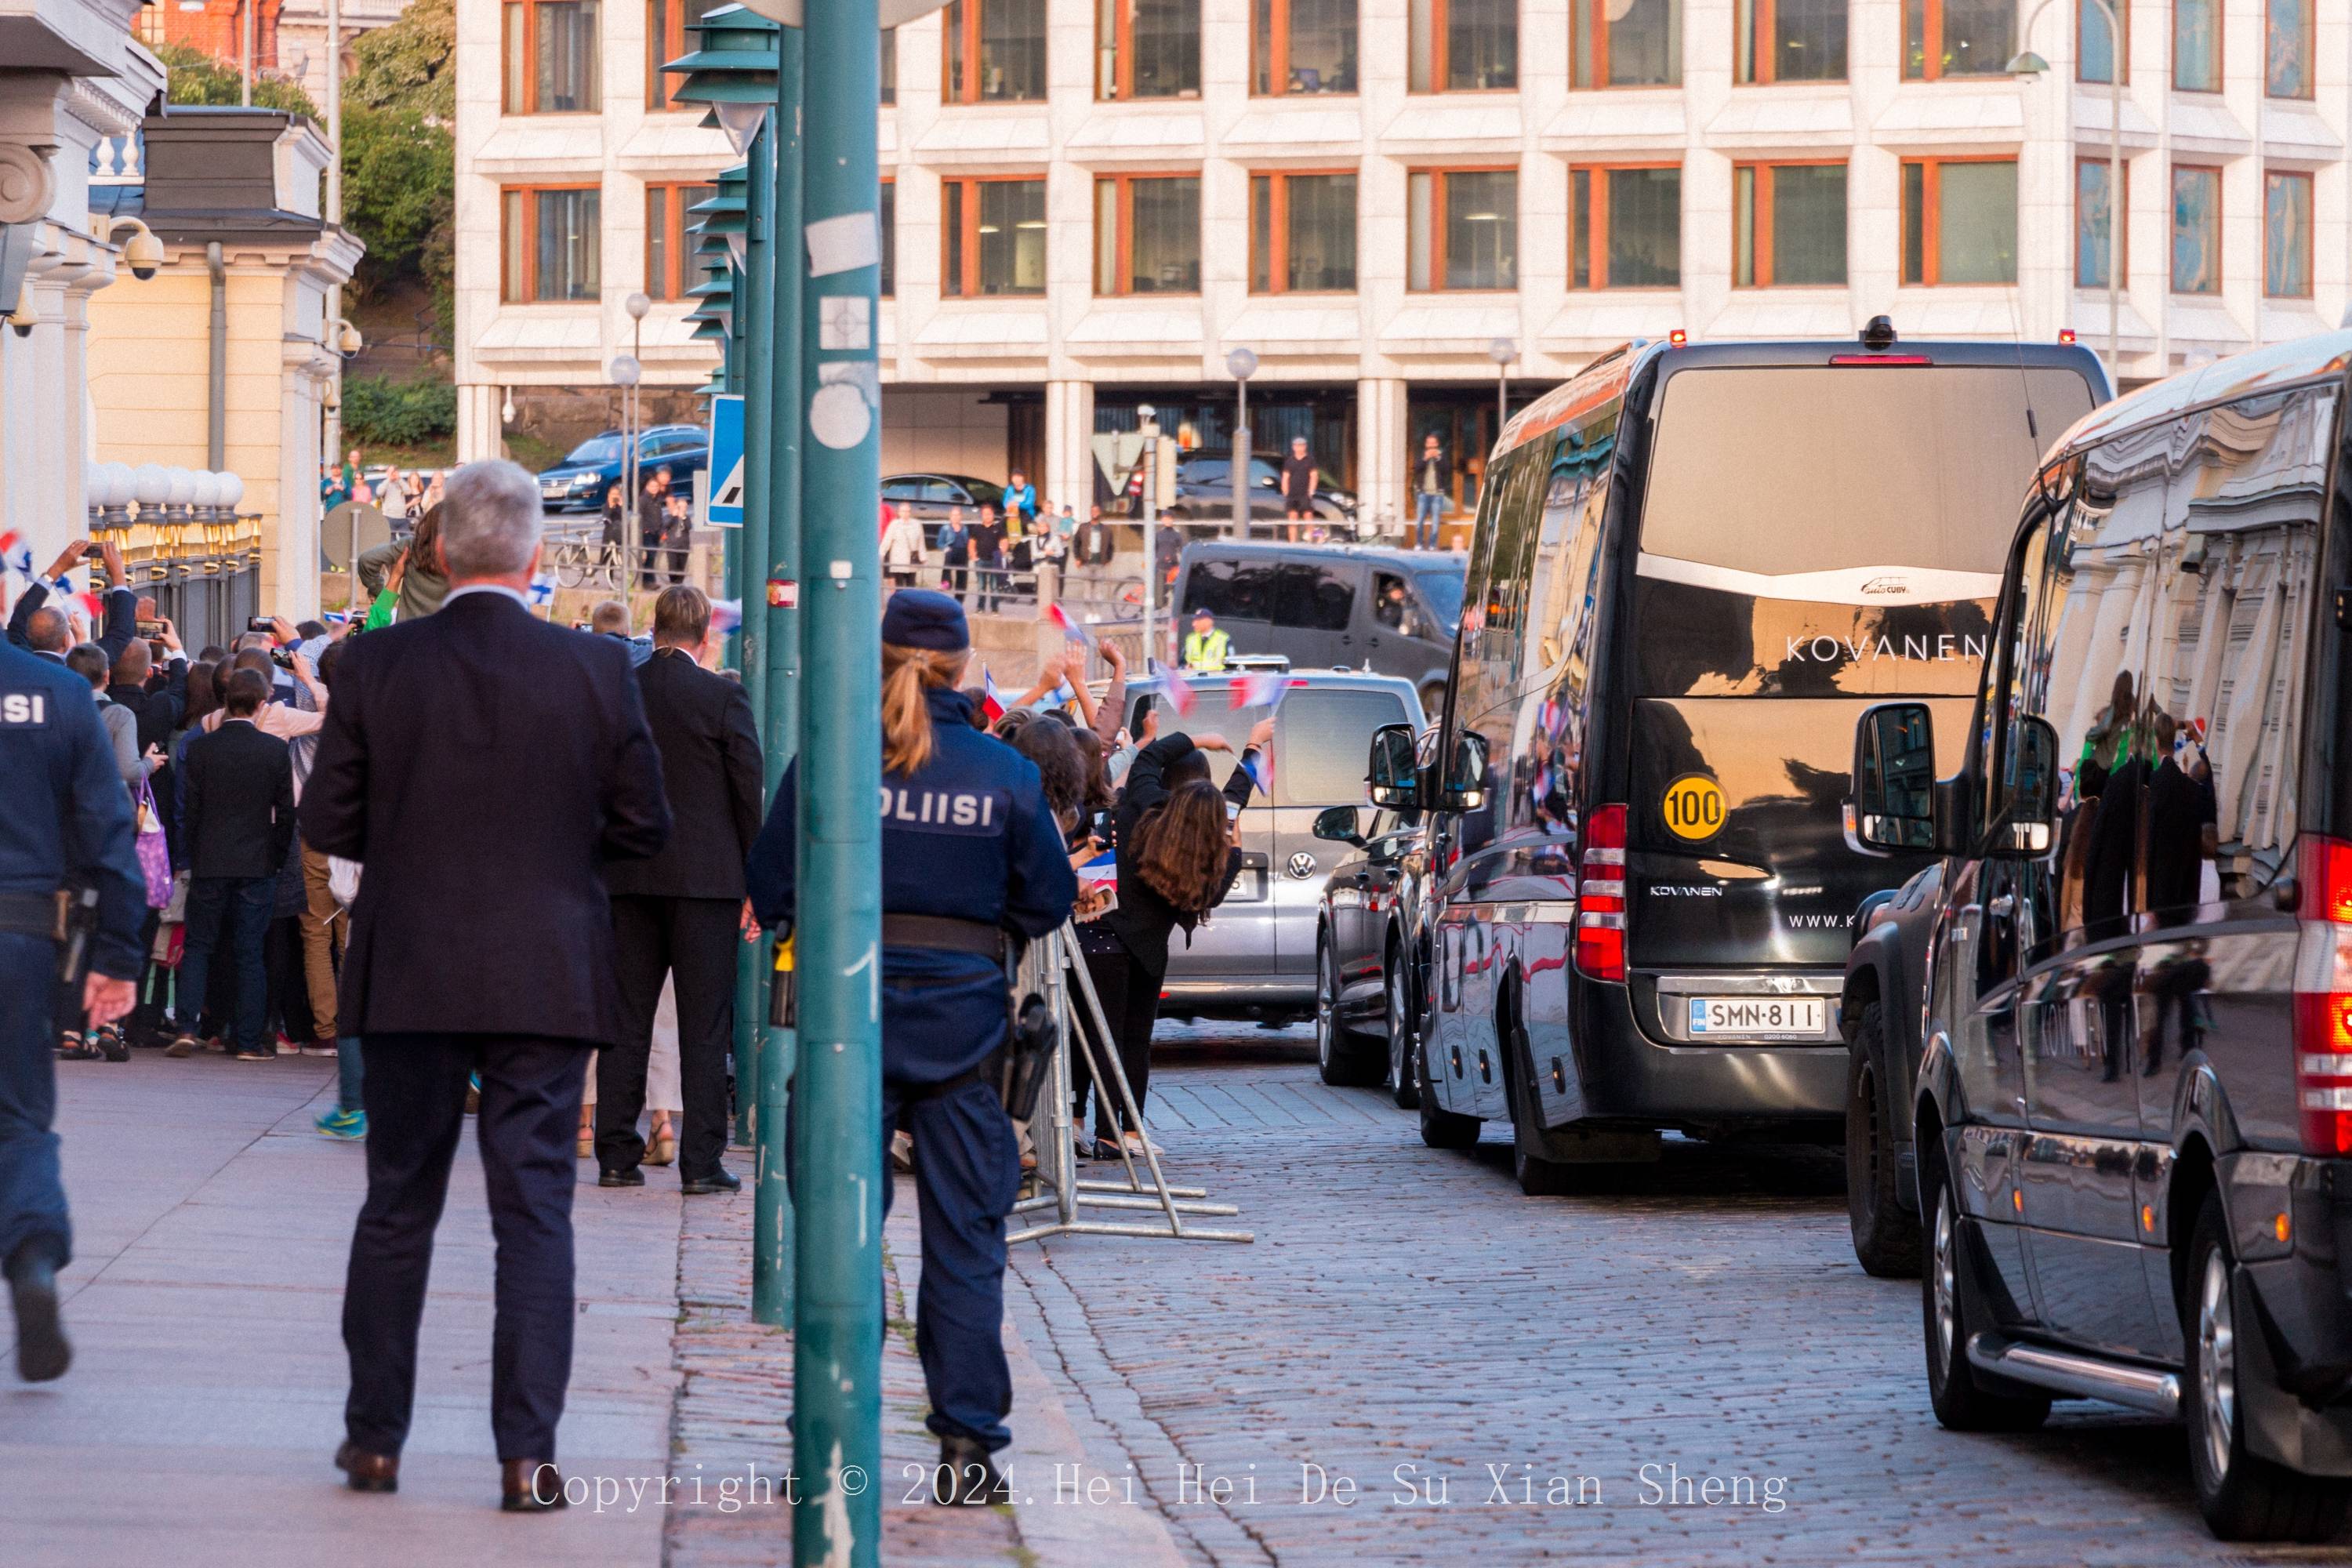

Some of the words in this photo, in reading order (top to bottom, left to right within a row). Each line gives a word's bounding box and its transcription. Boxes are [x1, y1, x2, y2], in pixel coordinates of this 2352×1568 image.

[1787, 634, 1987, 662] KOVANEN
[0, 695, 44, 723] SI
[879, 786, 993, 826] OLIISI
[1668, 790, 1720, 826] 100
[1650, 886, 1722, 896] KOVANEN
[1712, 1004, 1811, 1027] SMN-811
[2041, 1003, 2107, 1057] KOVEN
